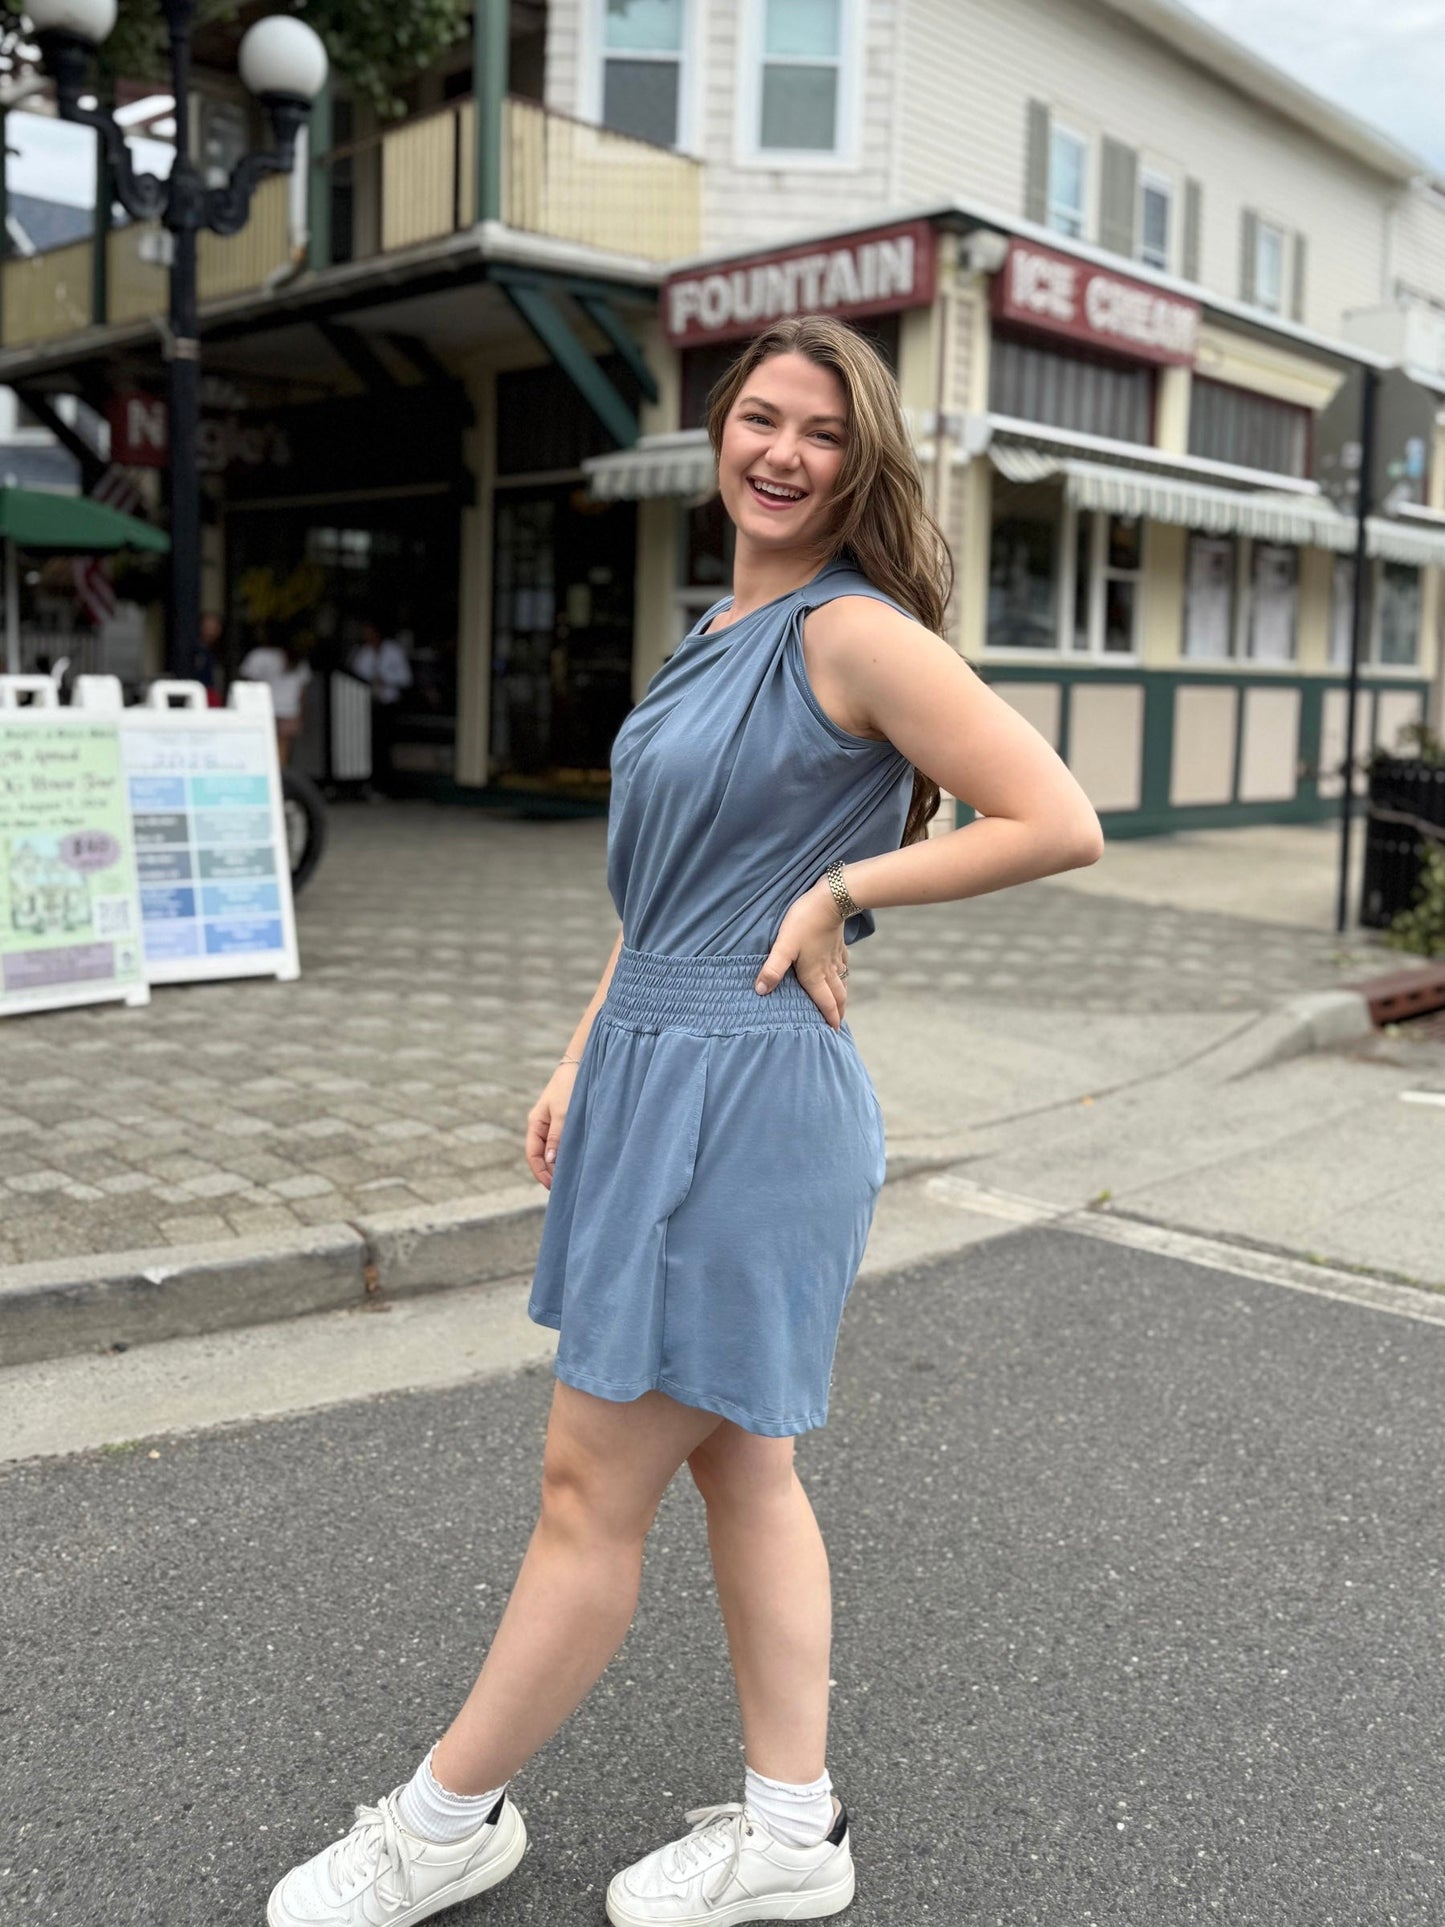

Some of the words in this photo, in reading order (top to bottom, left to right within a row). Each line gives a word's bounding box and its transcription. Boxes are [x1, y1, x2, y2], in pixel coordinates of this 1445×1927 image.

[669, 236, 915, 335] FOUNTAIN
[1011, 249, 1075, 322] ICE
[1084, 275, 1197, 356] CREAM
